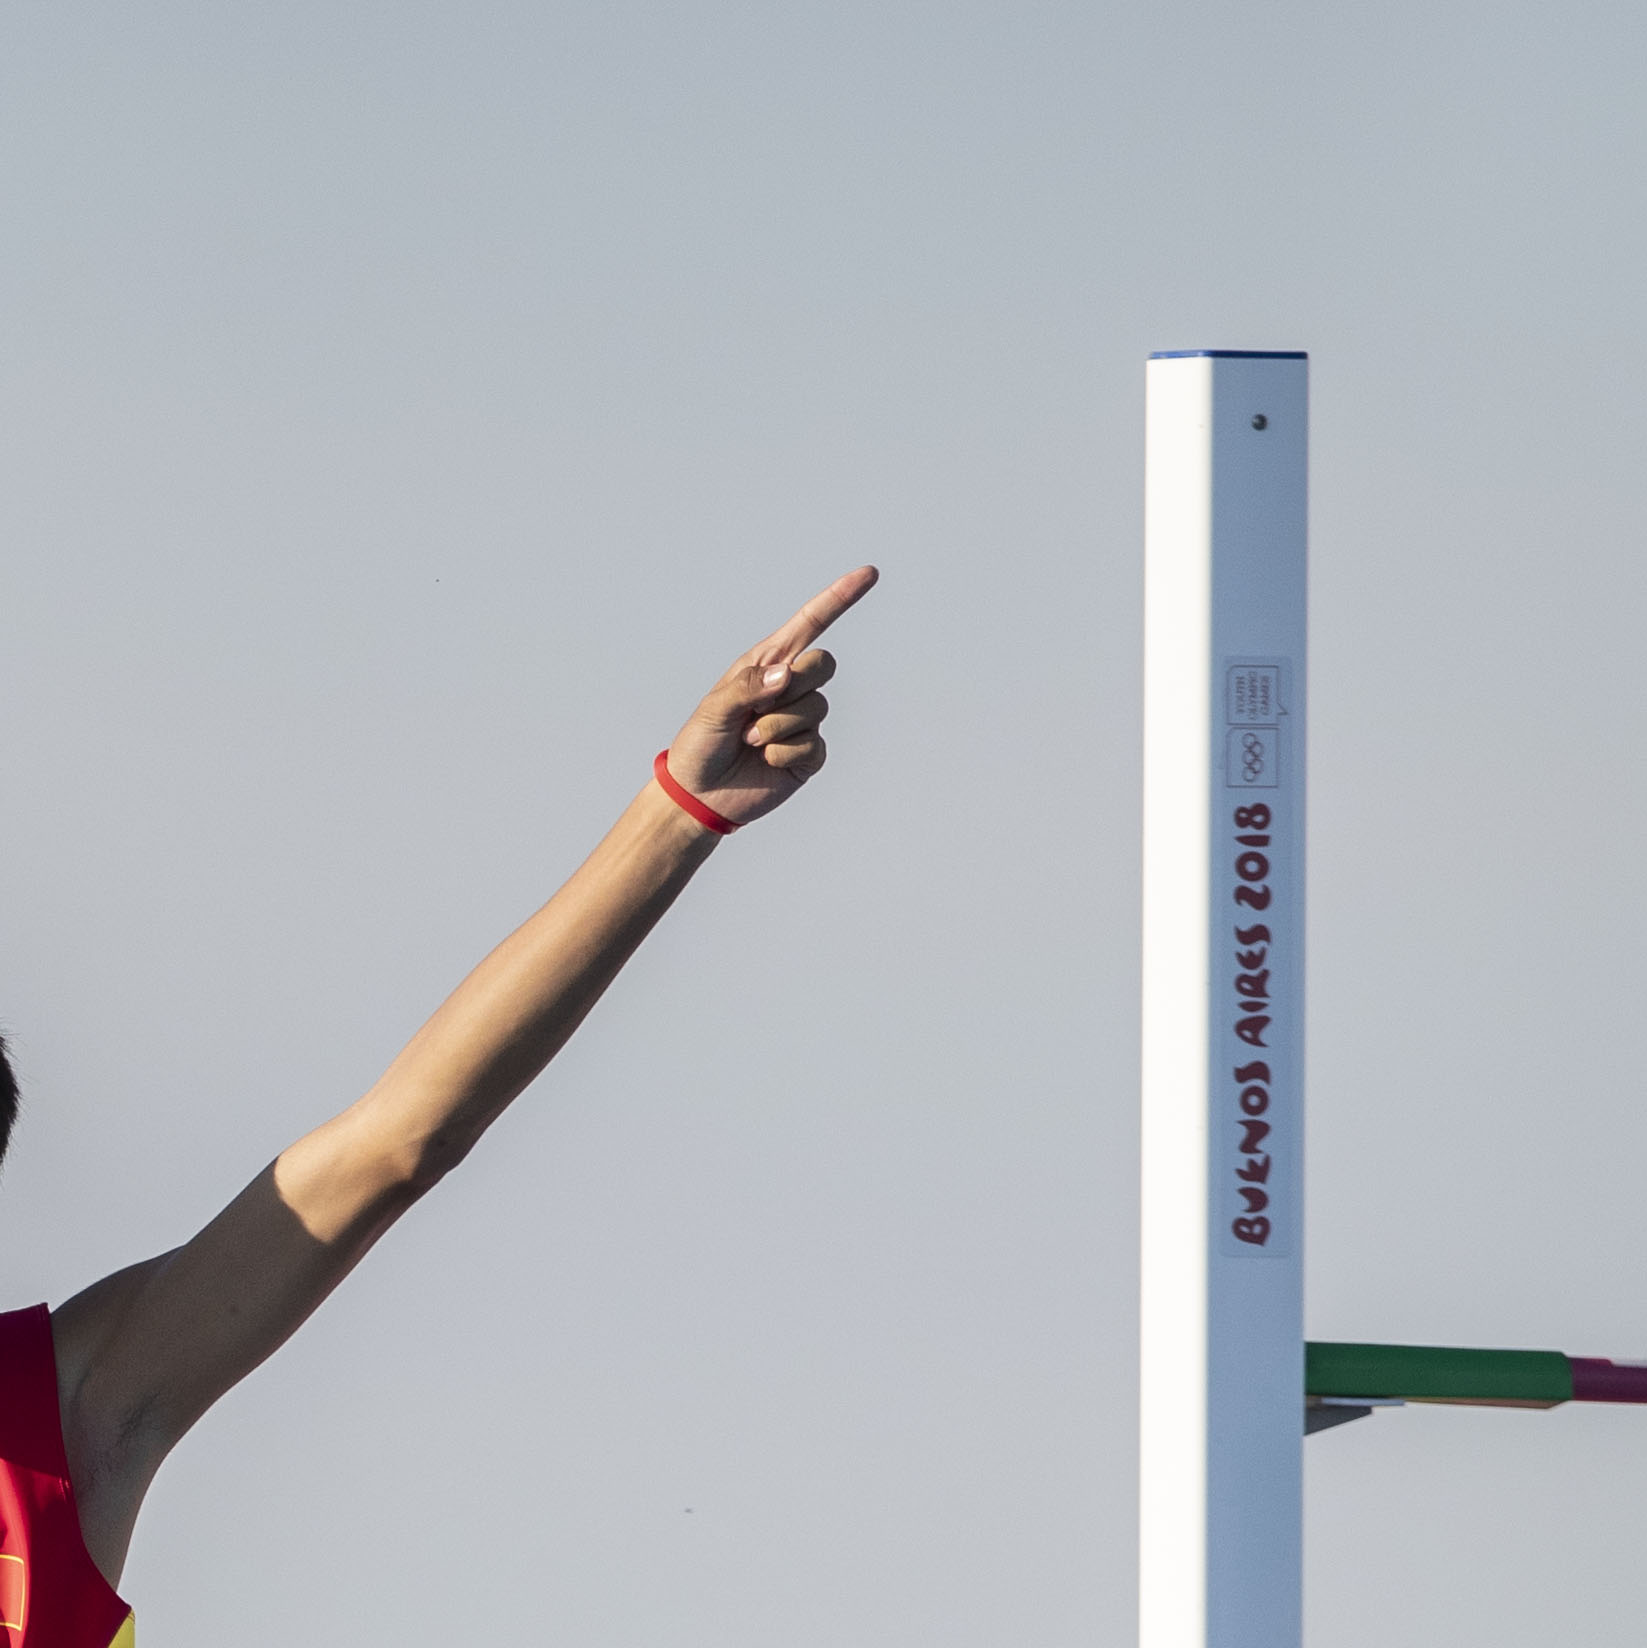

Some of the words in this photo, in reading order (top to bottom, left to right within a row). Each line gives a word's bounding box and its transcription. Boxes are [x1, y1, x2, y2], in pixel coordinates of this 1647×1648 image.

[1233, 802, 1272, 911] 2018
[1233, 923, 1272, 1048] AIRES
[1231, 1060, 1272, 1247] BUENOS
